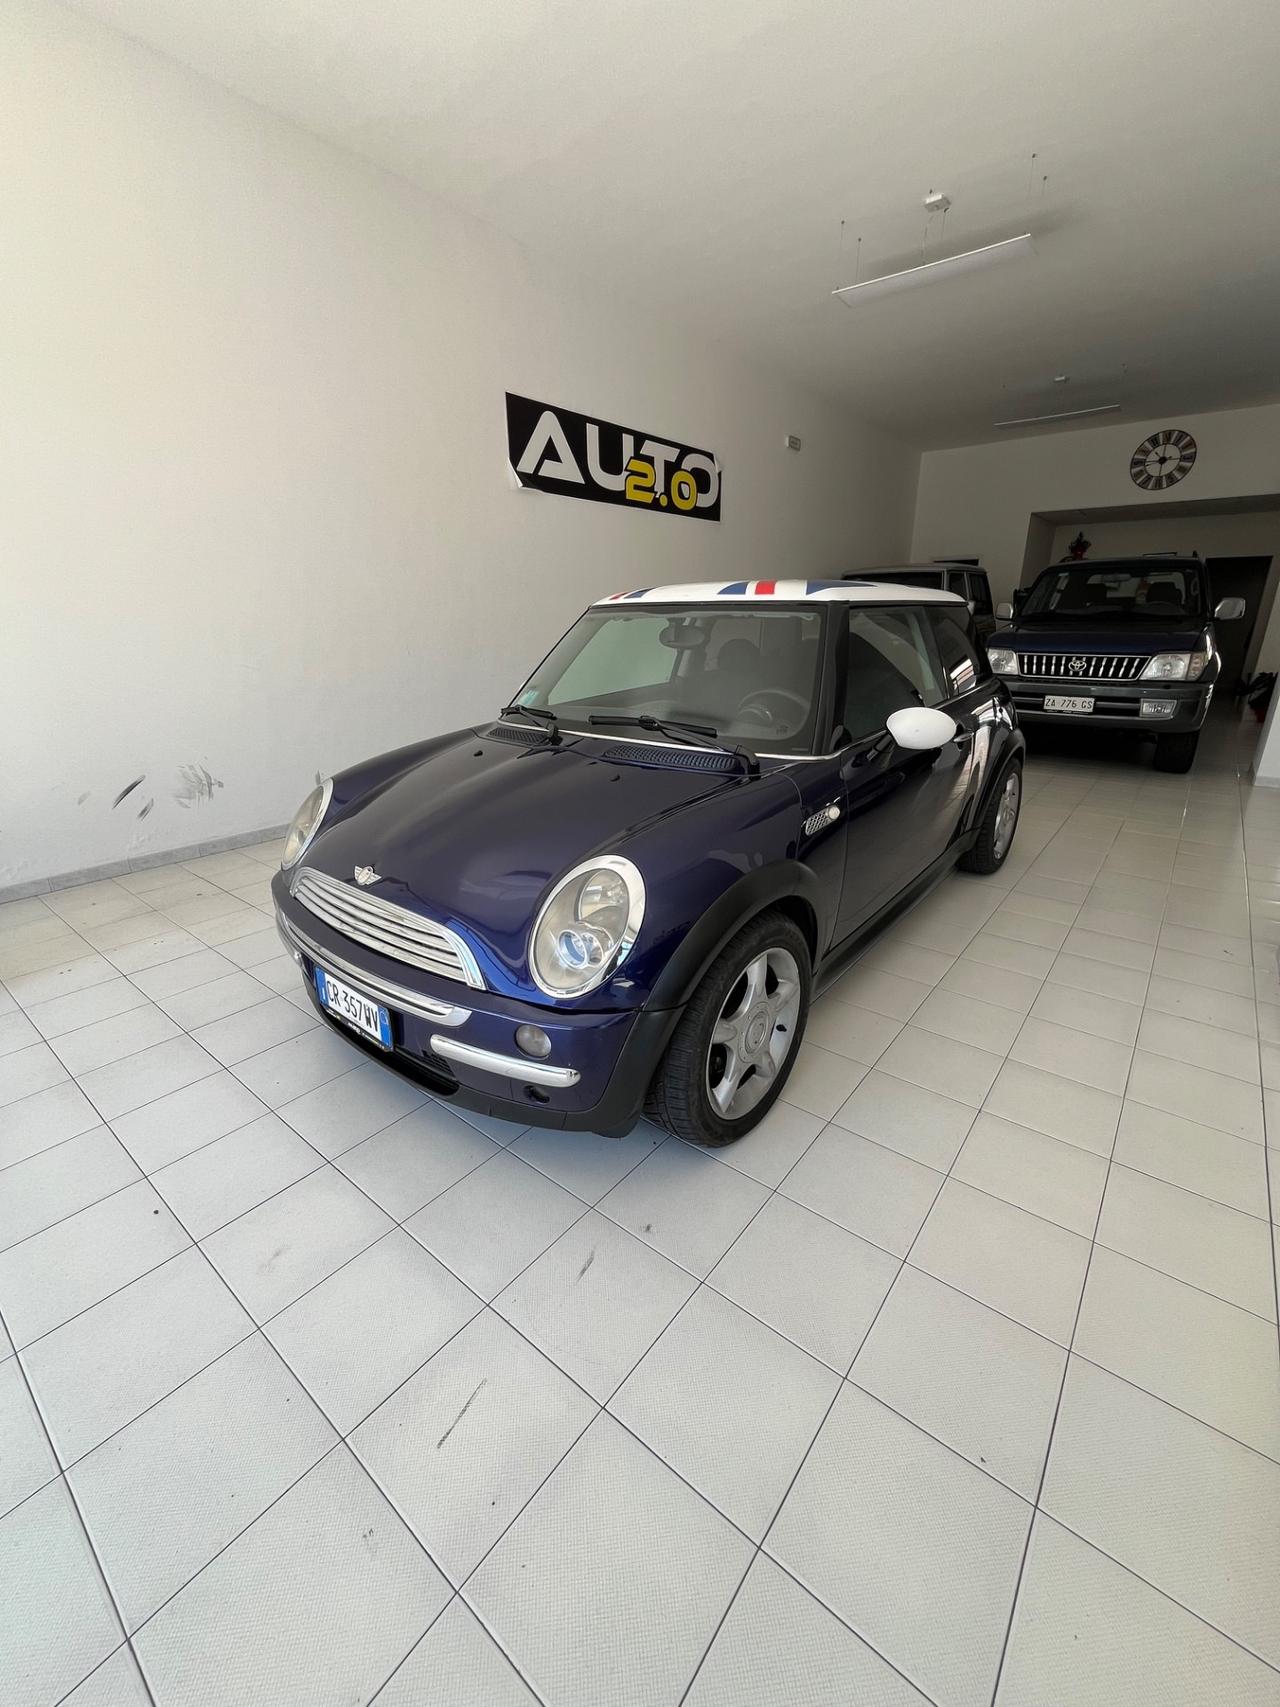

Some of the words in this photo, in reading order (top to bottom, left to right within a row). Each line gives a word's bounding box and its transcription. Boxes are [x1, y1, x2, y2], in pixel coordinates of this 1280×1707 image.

[516, 410, 719, 508] AUTO
[625, 458, 697, 511] 2.0
[1045, 698, 1056, 707] ZA
[1060, 699, 1077, 708] 776
[1081, 700, 1093, 709] GS
[326, 980, 341, 1008] CR
